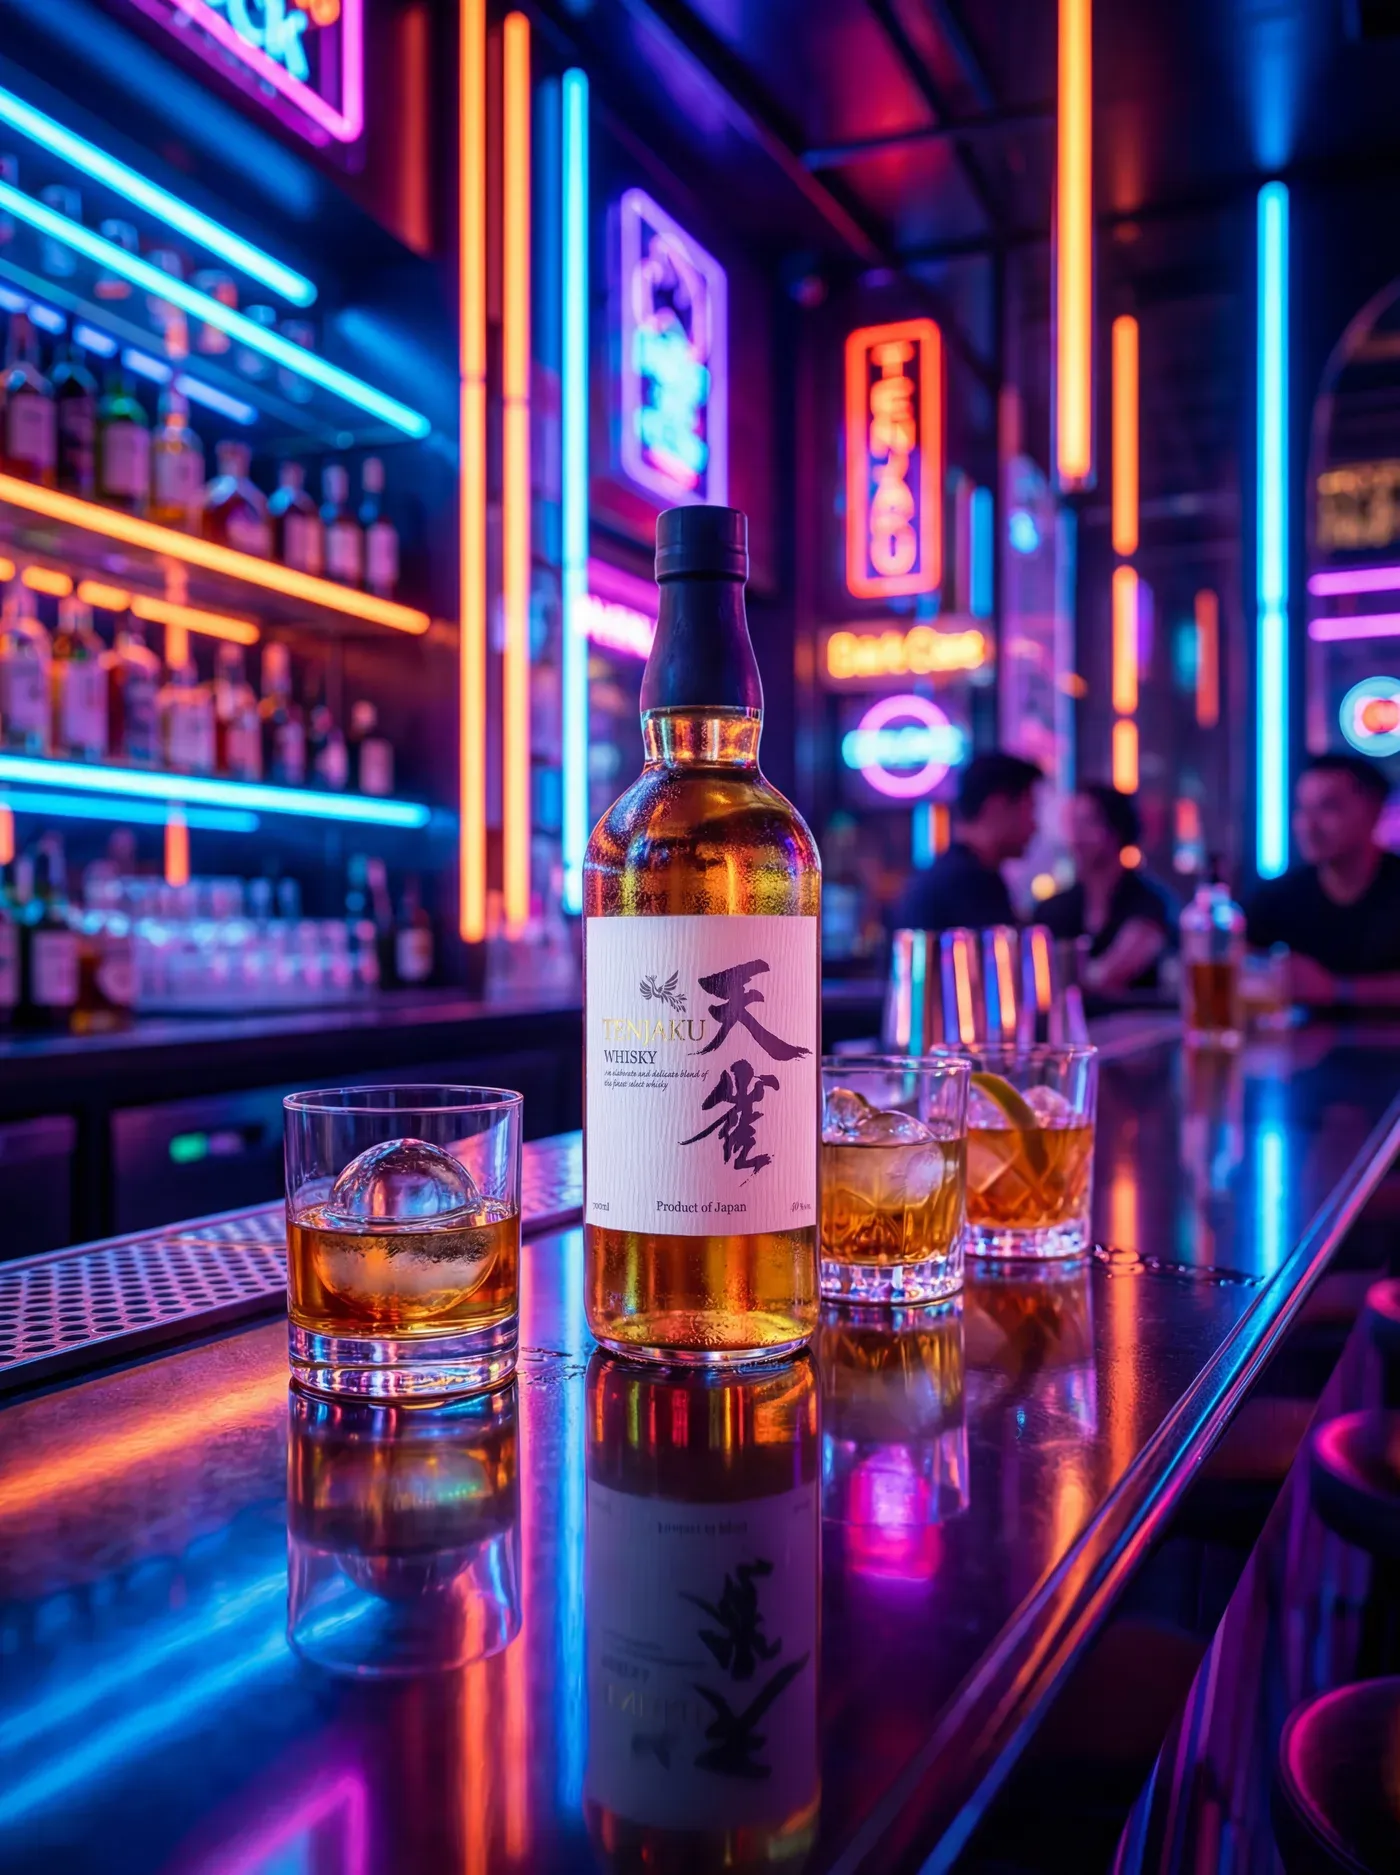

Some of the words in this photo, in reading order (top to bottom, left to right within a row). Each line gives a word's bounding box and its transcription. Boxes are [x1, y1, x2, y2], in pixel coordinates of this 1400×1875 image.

[603, 1018, 706, 1046] TENJAKU
[604, 1049, 657, 1064] WHISKY
[638, 1069, 650, 1078] and
[652, 1069, 678, 1078] delicate
[680, 1069, 700, 1078] blend
[701, 1070, 709, 1082] of
[678, 958, 813, 1187] 天雀
[628, 1080, 644, 1088] select
[645, 1080, 668, 1092] whisky
[656, 1200, 698, 1213] Product
[701, 1202, 713, 1213] of
[714, 1202, 747, 1215] Japan
